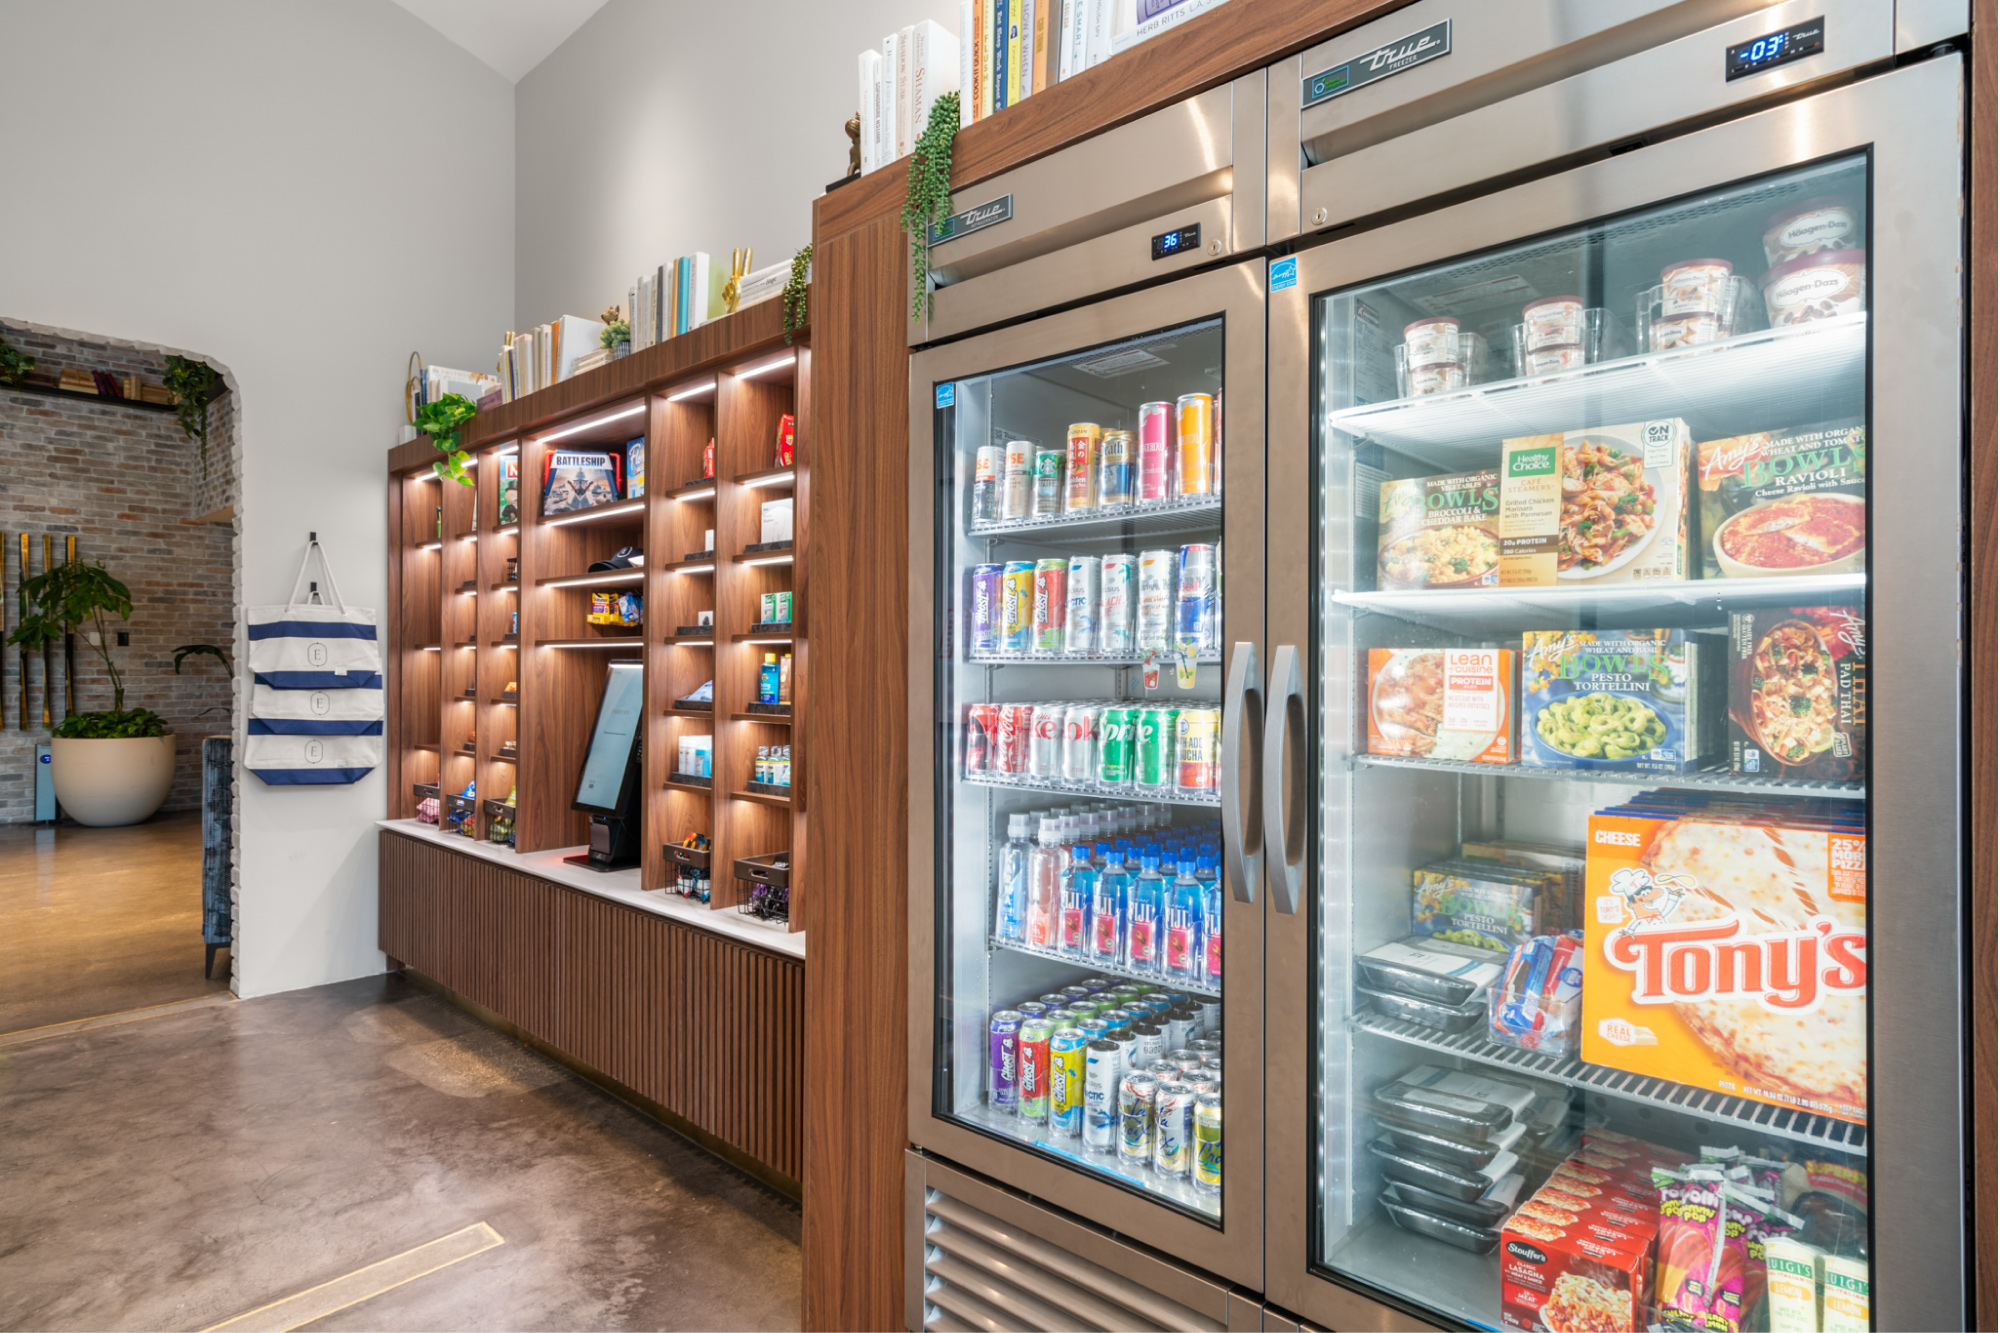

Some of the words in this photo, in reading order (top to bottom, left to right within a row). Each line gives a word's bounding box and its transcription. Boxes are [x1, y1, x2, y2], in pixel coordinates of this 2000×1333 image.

[1075, 12, 1083, 46] SMART
[1136, 21, 1160, 37] HERB
[1161, 8, 1186, 25] RITTS
[900, 34, 908, 75] SHADOW
[1389, 54, 1418, 70] FREEZER
[915, 67, 925, 124] SHAMAN
[1164, 233, 1178, 249] 36
[1775, 279, 1839, 300] Häagen-Dazs
[1648, 425, 1669, 436] ON
[1649, 434, 1669, 443] TRACK
[1766, 438, 1793, 448] MADE
[1795, 432, 1823, 444] WITH
[1761, 444, 1799, 457] WHEAT
[1799, 441, 1821, 451] AND
[556, 456, 606, 467] BATTLESHIP
[1517, 453, 1549, 463] Healthy
[1701, 434, 1768, 481] Amy's
[1512, 460, 1551, 471] Choice
[1426, 479, 1445, 487] MADE
[1446, 477, 1464, 485] WITH
[1465, 473, 1498, 483] ORGANIC
[1521, 477, 1542, 486] CAFÉ
[1775, 467, 1846, 486] RAVIOLI
[1441, 481, 1482, 492] VEGETABLES
[1508, 484, 1555, 493] STEAMERS
[1755, 488, 1785, 497] Cheese
[1787, 484, 1816, 494] Ravioli
[1818, 481, 1838, 489] with
[1411, 487, 1499, 517] BOWLS
[1505, 499, 1527, 507] Grilled
[1528, 497, 1555, 505] Chicken
[1505, 504, 1533, 512] Marinara
[1428, 508, 1472, 518] BROCCOLI
[1473, 506, 1481, 514] &
[1521, 510, 1552, 518] Parmesan
[1421, 515, 1463, 527] CHEDDAR
[1464, 513, 1487, 522] BAKE
[1516, 537, 1547, 545] PROTEIN
[1627, 639, 1666, 647] ORGANIC
[314, 649, 321, 661] E
[1527, 634, 1579, 667] Amy's
[1450, 653, 1492, 666] Lean
[1558, 654, 1669, 680] BOWLS
[1451, 677, 1492, 686] PROTEIN
[1591, 673, 1632, 682] PESTO
[1840, 663, 1851, 688] PAD
[1574, 682, 1650, 692] TORTELLINI
[317, 698, 323, 709] E
[1840, 692, 1851, 724] THAI
[310, 746, 317, 757] E
[1594, 829, 1641, 847] CHEESE
[1416, 877, 1457, 899] Amy's
[1440, 895, 1522, 927] BOWLS
[1464, 913, 1495, 925] PESTO
[1451, 918, 1508, 935] TORTELLINI
[1611, 919, 1866, 1009] Tony's
[1607, 1024, 1631, 1036] REAL
[1607, 1033, 1631, 1042] CHEESE
[1001, 1044, 1016, 1082] GHOST
[1021, 1051, 1036, 1094] GHOST
[1053, 1063, 1067, 1106] GHOST
[1718, 1080, 1735, 1091] PIZZA
[1743, 1086, 1753, 1094] NET
[1128, 1098, 1146, 1124] La
[1684, 1211, 1707, 1223] POP
[1507, 1243, 1546, 1262] Stouffer's
[1509, 1264, 1545, 1280] LASAGNA
[1517, 1261, 1536, 1271] CLASSIC
[1527, 1276, 1542, 1284] SAUCE
[1778, 1273, 1804, 1282] ITALIAN
[1518, 1292, 1535, 1302] MEAT
[1775, 1283, 1803, 1300] LEMON
[1836, 1288, 1865, 1299] ITALIAN
[1833, 1299, 1862, 1316] LEMON
